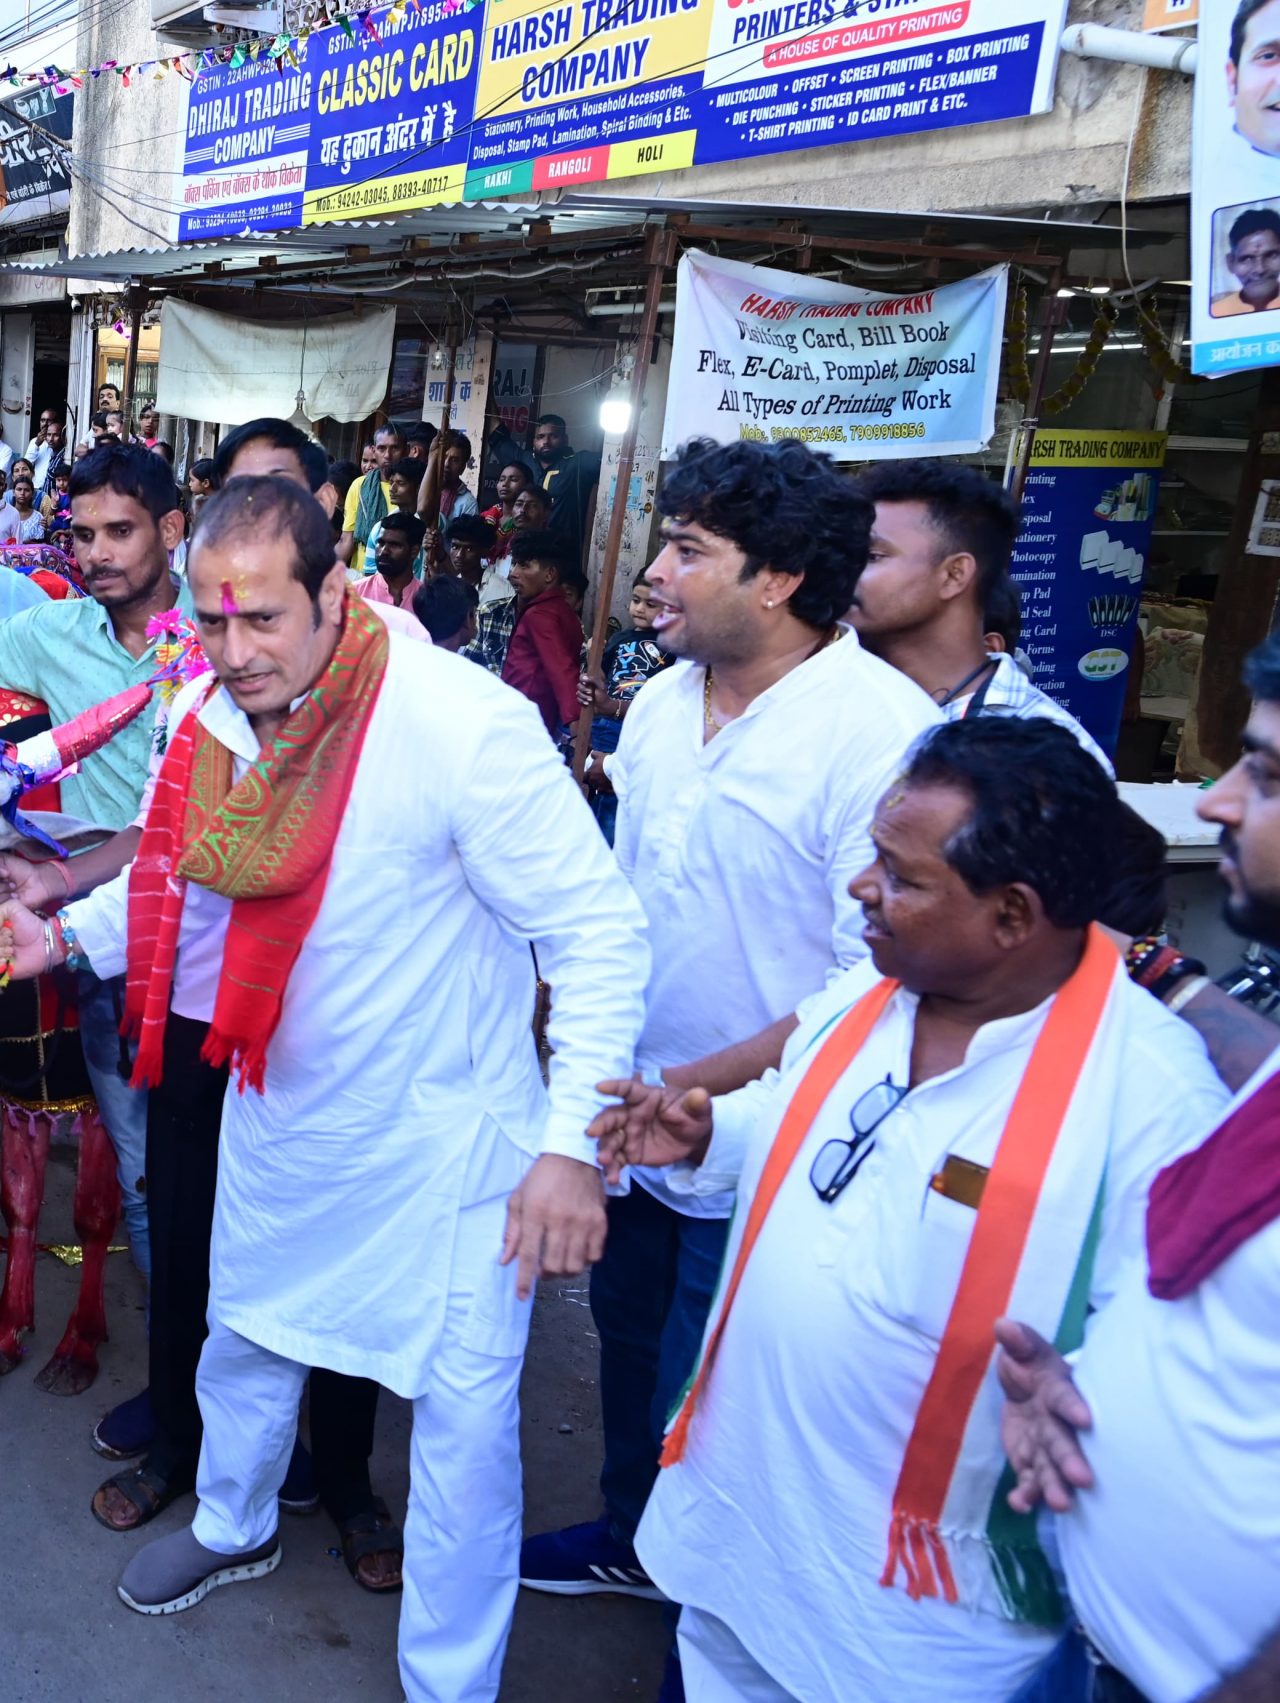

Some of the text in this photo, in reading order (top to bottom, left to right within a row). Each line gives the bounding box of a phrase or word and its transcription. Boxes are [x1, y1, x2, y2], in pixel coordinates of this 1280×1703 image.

[491, 6, 573, 61] HARSH
[733, 0, 835, 44] PRINTERS
[768, 7, 963, 62] A HOUSE OF QUALITY PRINTING
[198, 74, 220, 94] GSTIN
[318, 28, 474, 115] CLASSIC CARD
[521, 38, 650, 102] COMPANY
[716, 34, 1030, 108] MULTICOLOUR OFFSET SCREEN PRINTING BOX PRINTING
[188, 72, 312, 138] DHIRAJ TRADING
[732, 64, 998, 126] DIE PUNCHING STICKER PRINTING FLEX/BANNER
[484, 118, 522, 138] Stationery,
[524, 111, 556, 128] Printing
[557, 107, 580, 123] Work,
[582, 96, 627, 117] Household
[748, 93, 968, 142] T-SHIRT PRINTING ID CARD PRINT & ETC.
[214, 125, 276, 164] COMPANY
[320, 100, 457, 175] यह दुकान अंदर में है
[472, 106, 692, 160] Disposal, Stamp Pad, Lamination, Spiral Binding & Etc.
[548, 156, 592, 178] RANGOLI
[637, 144, 664, 163] HOLI
[392, 176, 448, 200] 88393-40717
[484, 169, 512, 189] RAKHI
[740, 292, 800, 321] HARSH
[866, 291, 935, 316] COMPANY
[735, 319, 950, 354] Visiting Card, Bill Book
[696, 350, 976, 386] Flex, E-Card, Pomplet, Disposal
[718, 388, 952, 420] All Types of Printing Work
[850, 423, 926, 440] 7909918856
[1059, 440, 1108, 458] TRADING
[1110, 439, 1165, 459] COMPANY
[1025, 472, 1056, 488] rinting
[1021, 492, 1036, 504] lex
[1022, 511, 1052, 526] sposal
[1010, 570, 1056, 582] amination
[1033, 587, 1051, 600] Pad
[1032, 606, 1052, 618] Seal
[1034, 624, 1057, 636] Card
[1100, 629, 1118, 638] DSC
[1026, 643, 1055, 655] Forms
